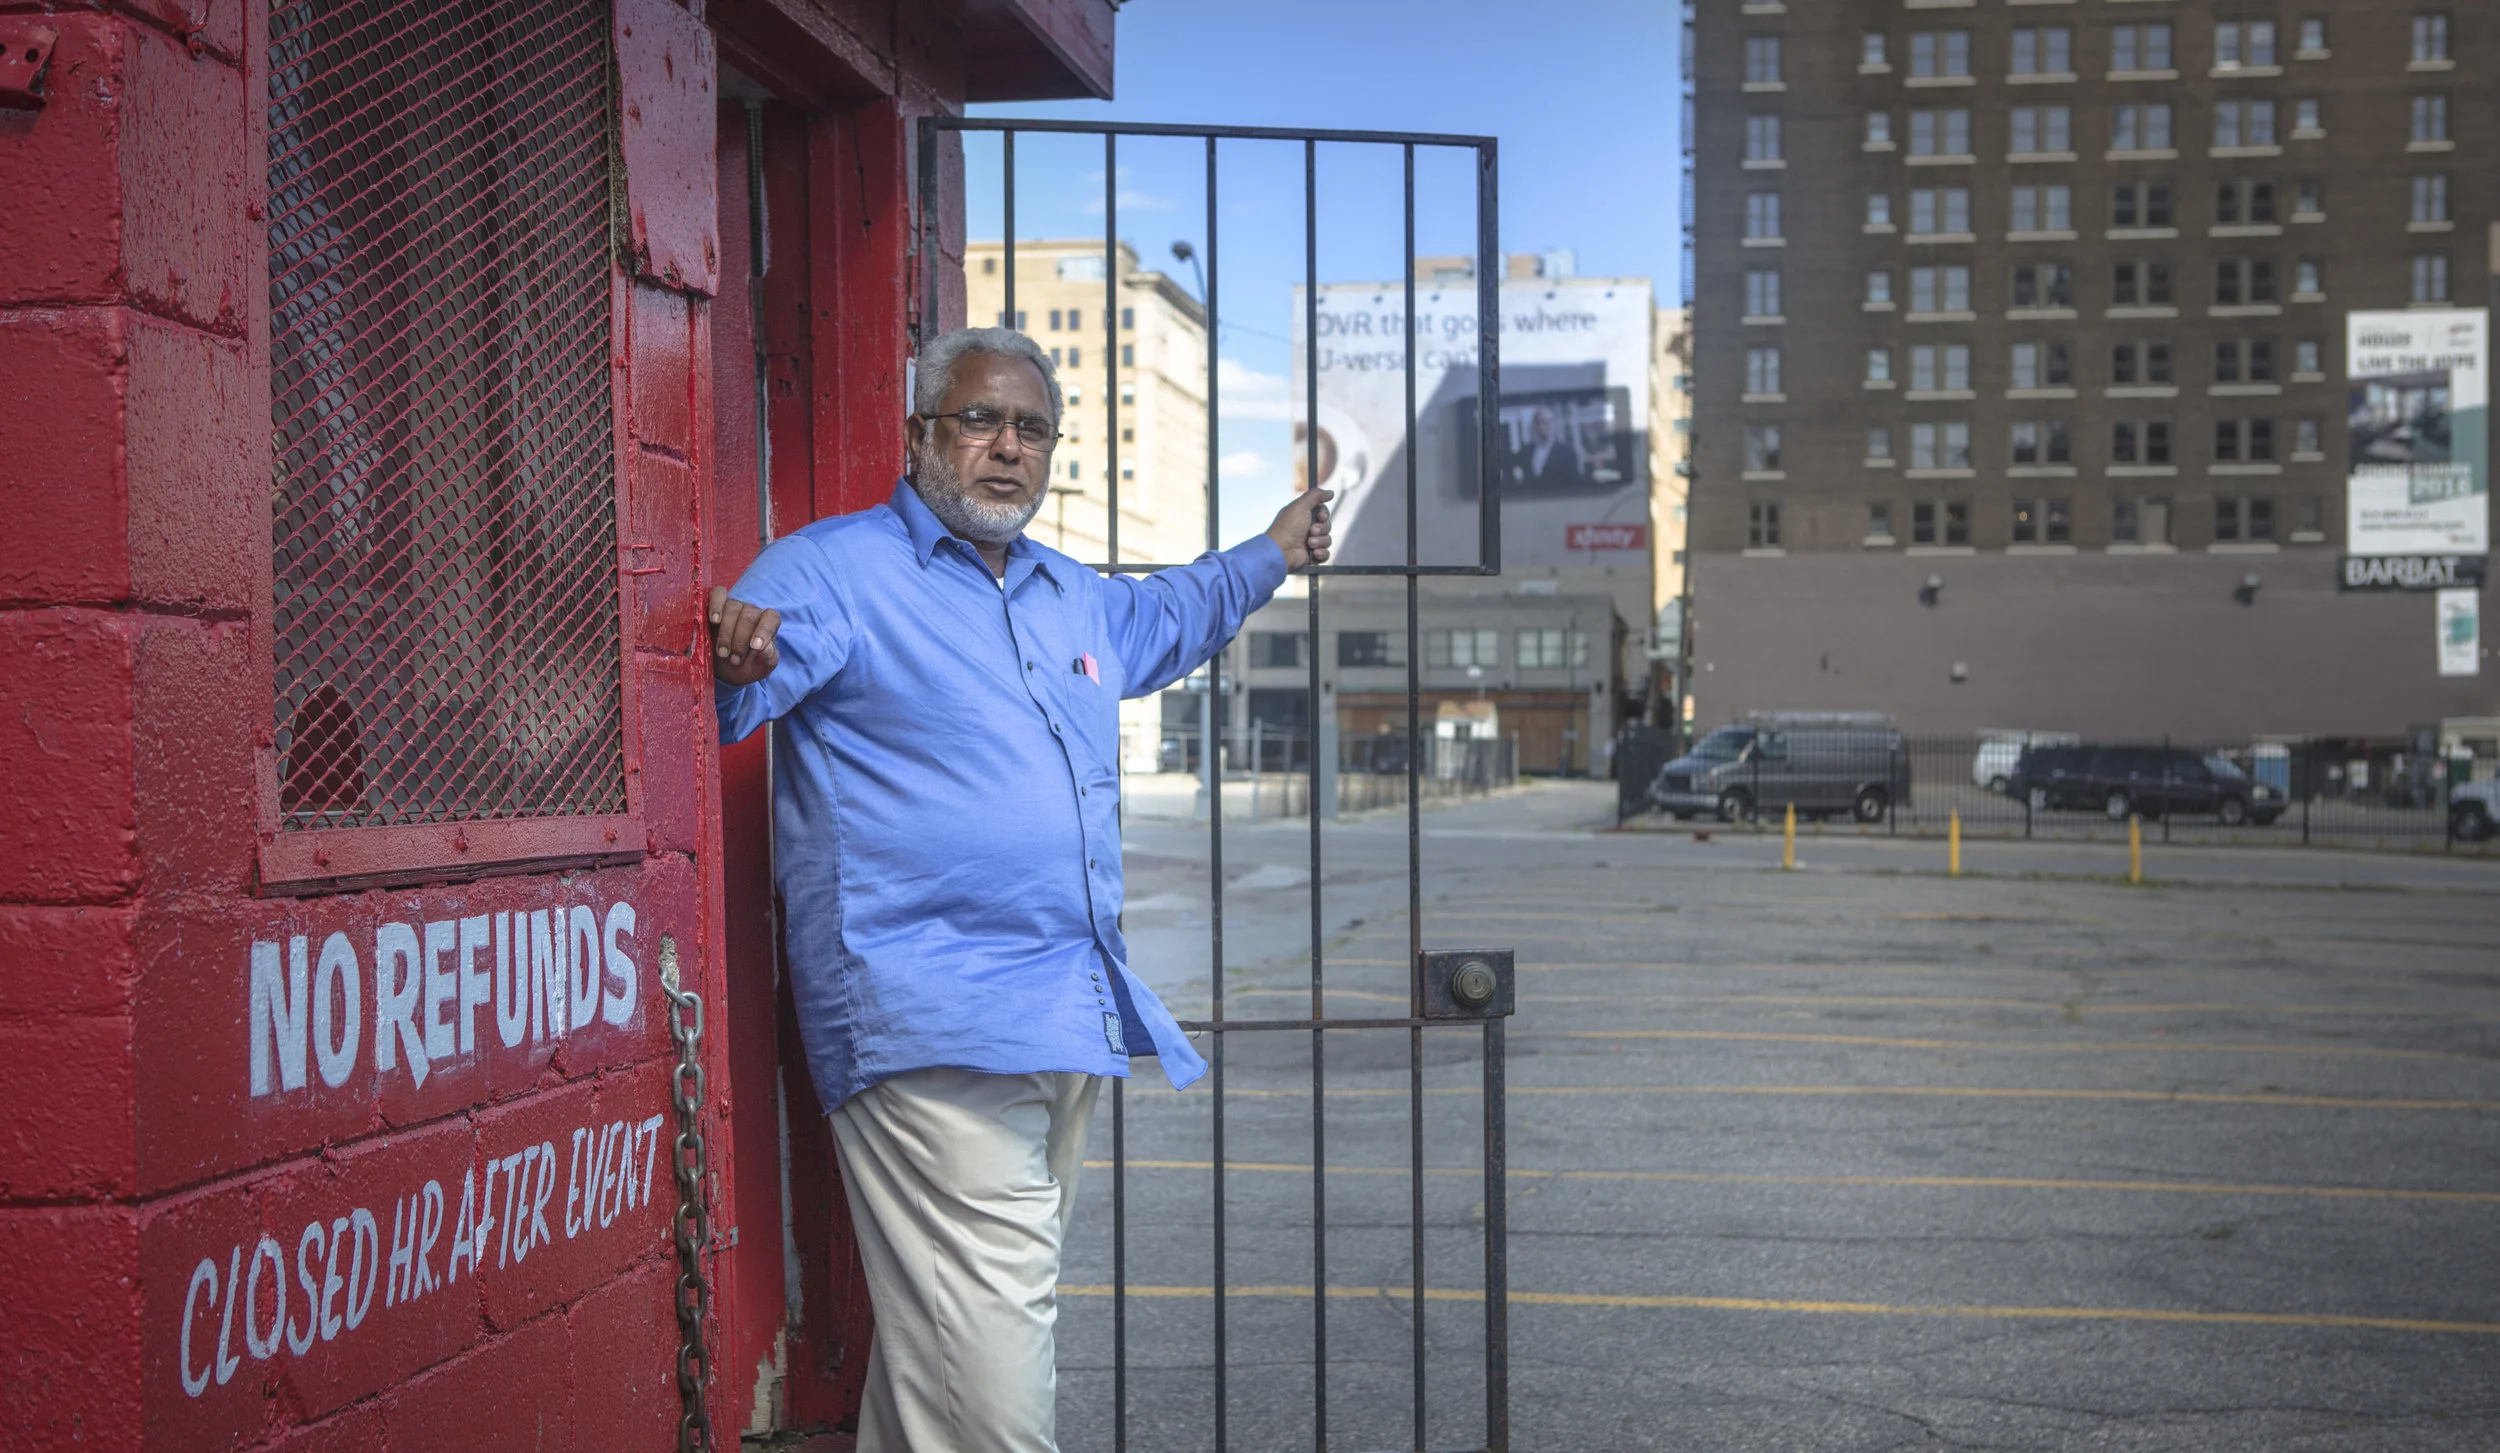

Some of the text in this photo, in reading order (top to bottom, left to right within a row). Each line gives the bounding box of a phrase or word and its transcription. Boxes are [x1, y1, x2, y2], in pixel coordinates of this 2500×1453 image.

[1316, 311, 1373, 337] DVR
[1440, 313, 1506, 341] gos
[1514, 306, 1598, 333] where
[2358, 353, 2477, 371] LIVE THE HYPE
[2346, 557, 2461, 586] BARBAT
[249, 901, 637, 1097] NO REFUNDS
[180, 1114, 664, 1397] CLOSED HR. AFTER EVENT
